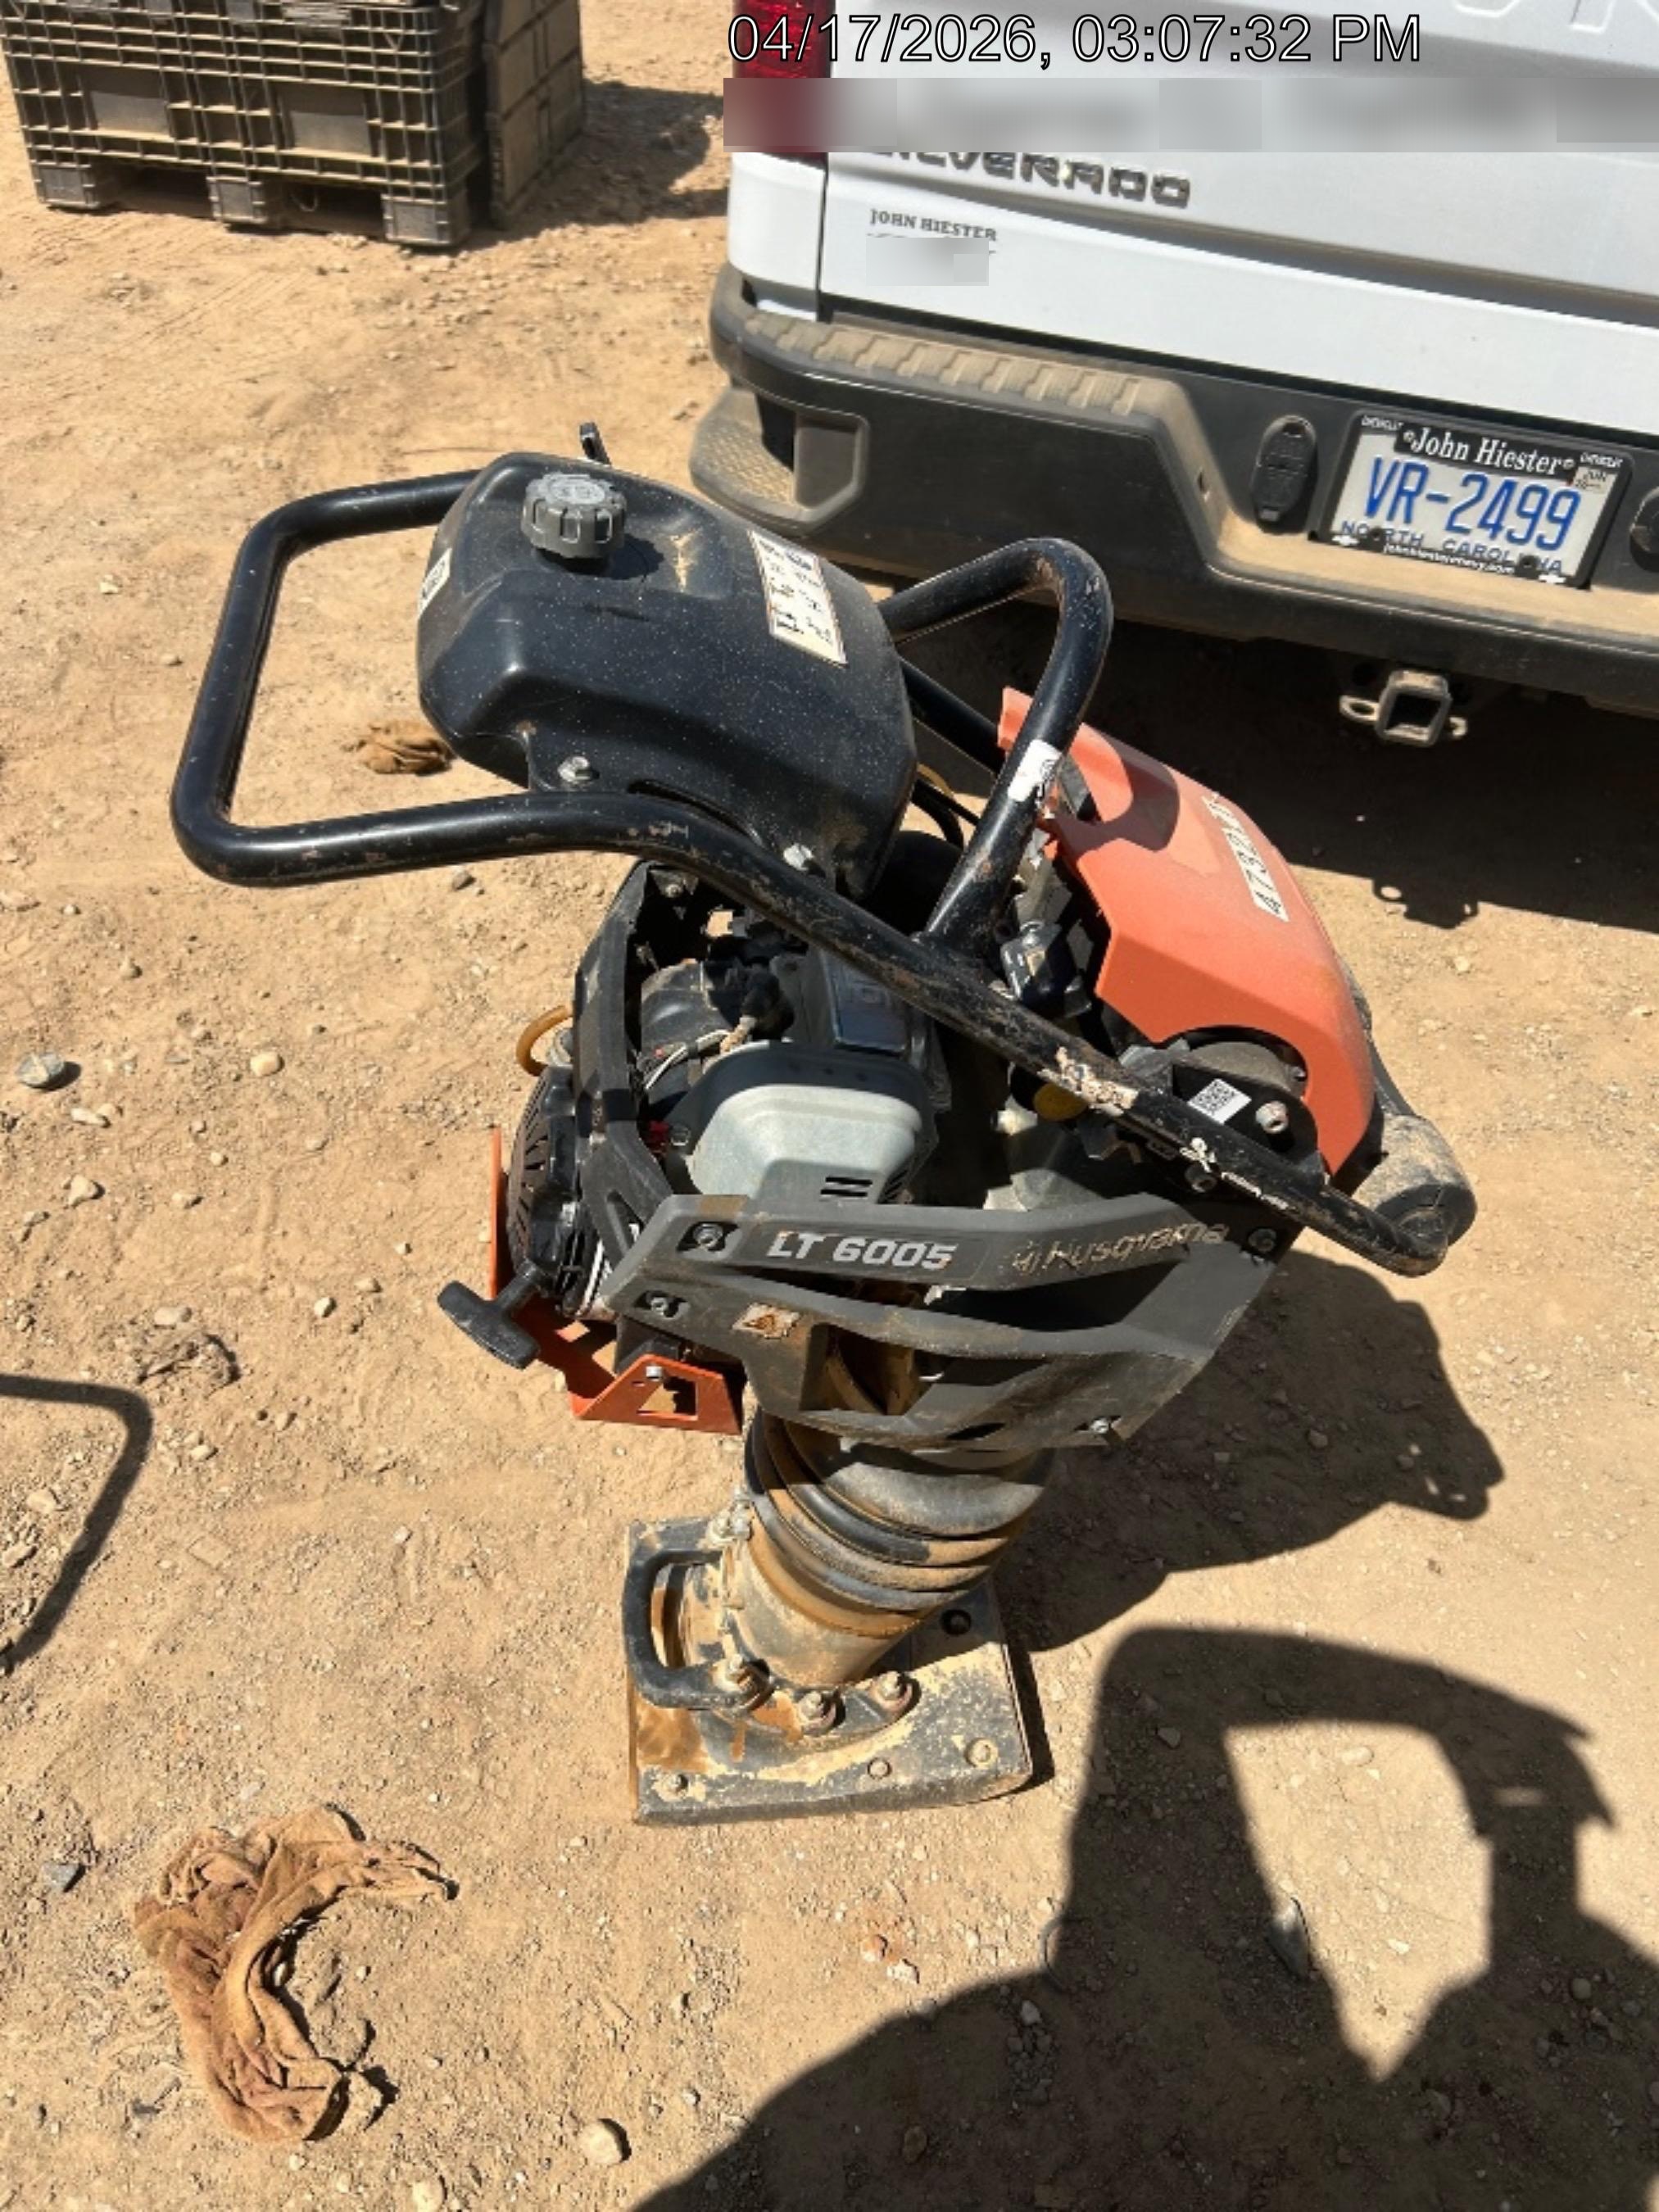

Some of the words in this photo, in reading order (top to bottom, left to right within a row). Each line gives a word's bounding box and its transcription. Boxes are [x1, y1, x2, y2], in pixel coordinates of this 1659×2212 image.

[870, 208, 917, 229] JOHN
[920, 217, 997, 242] HIESTER
[1410, 427, 1470, 461] John
[1474, 437, 1562, 475] Hiester
[1365, 456, 1581, 552] VR-2499
[767, 1231, 826, 1259] LT
[832, 1235, 959, 1271] 6005
